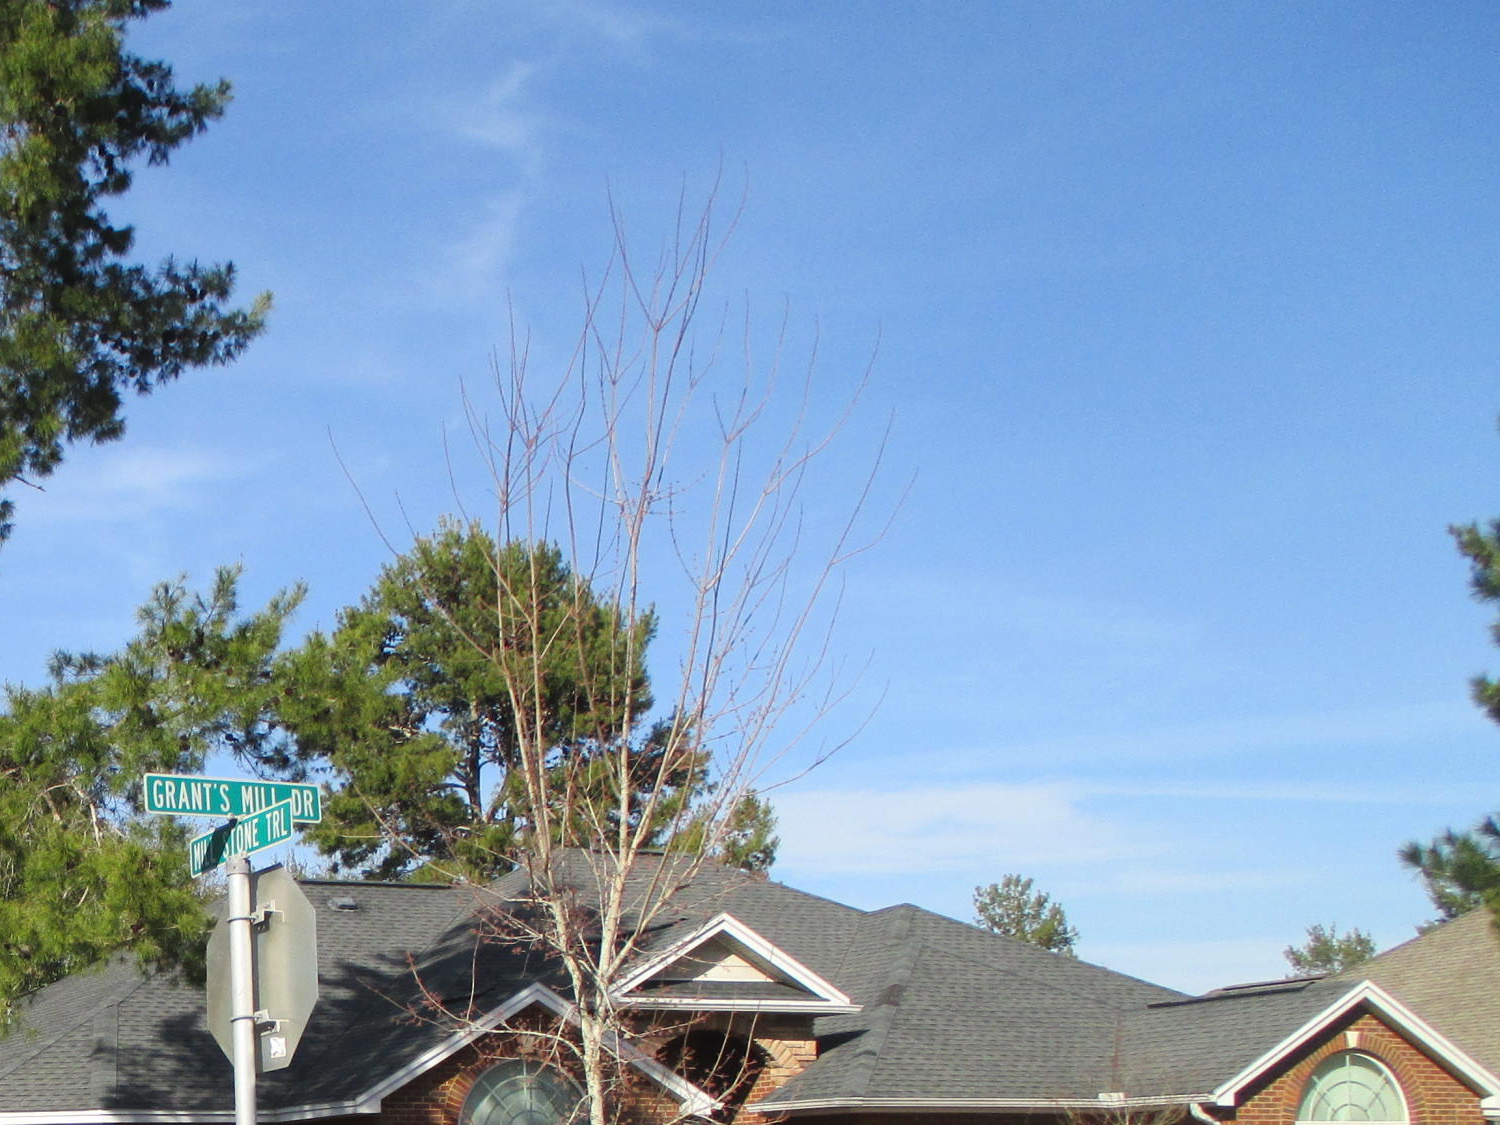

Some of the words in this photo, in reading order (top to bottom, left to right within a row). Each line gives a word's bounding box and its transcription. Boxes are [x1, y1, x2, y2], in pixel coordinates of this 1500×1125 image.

[153, 780, 230, 812] GRANT'S
[291, 788, 314, 817] DR
[266, 807, 288, 841] TRL
